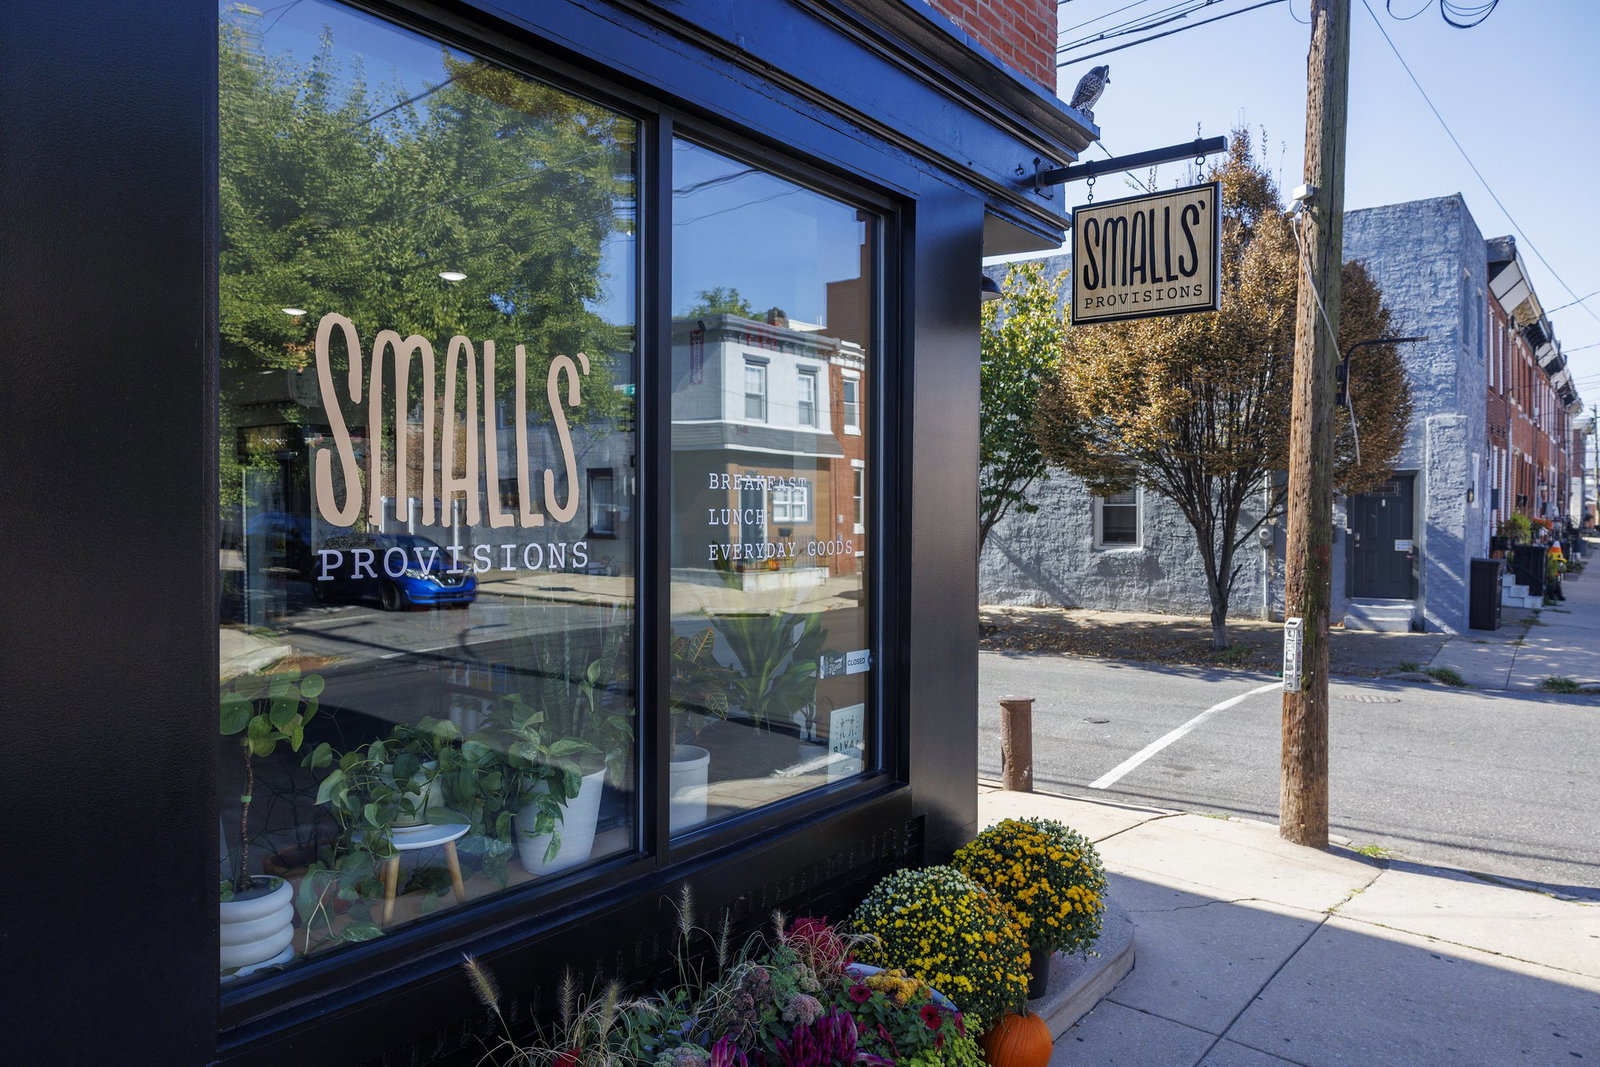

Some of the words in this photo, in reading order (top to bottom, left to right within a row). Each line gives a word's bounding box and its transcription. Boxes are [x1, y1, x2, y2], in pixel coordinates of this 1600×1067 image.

[1084, 284, 1203, 309] PROVISIONS
[708, 473, 807, 492] BREAKFAST
[708, 508, 765, 525] LUNCH
[708, 544, 797, 561] EVERYDAY
[808, 540, 853, 557] GOODS
[317, 541, 588, 581] PROVISIONS
[847, 657, 865, 667] CLOSED
